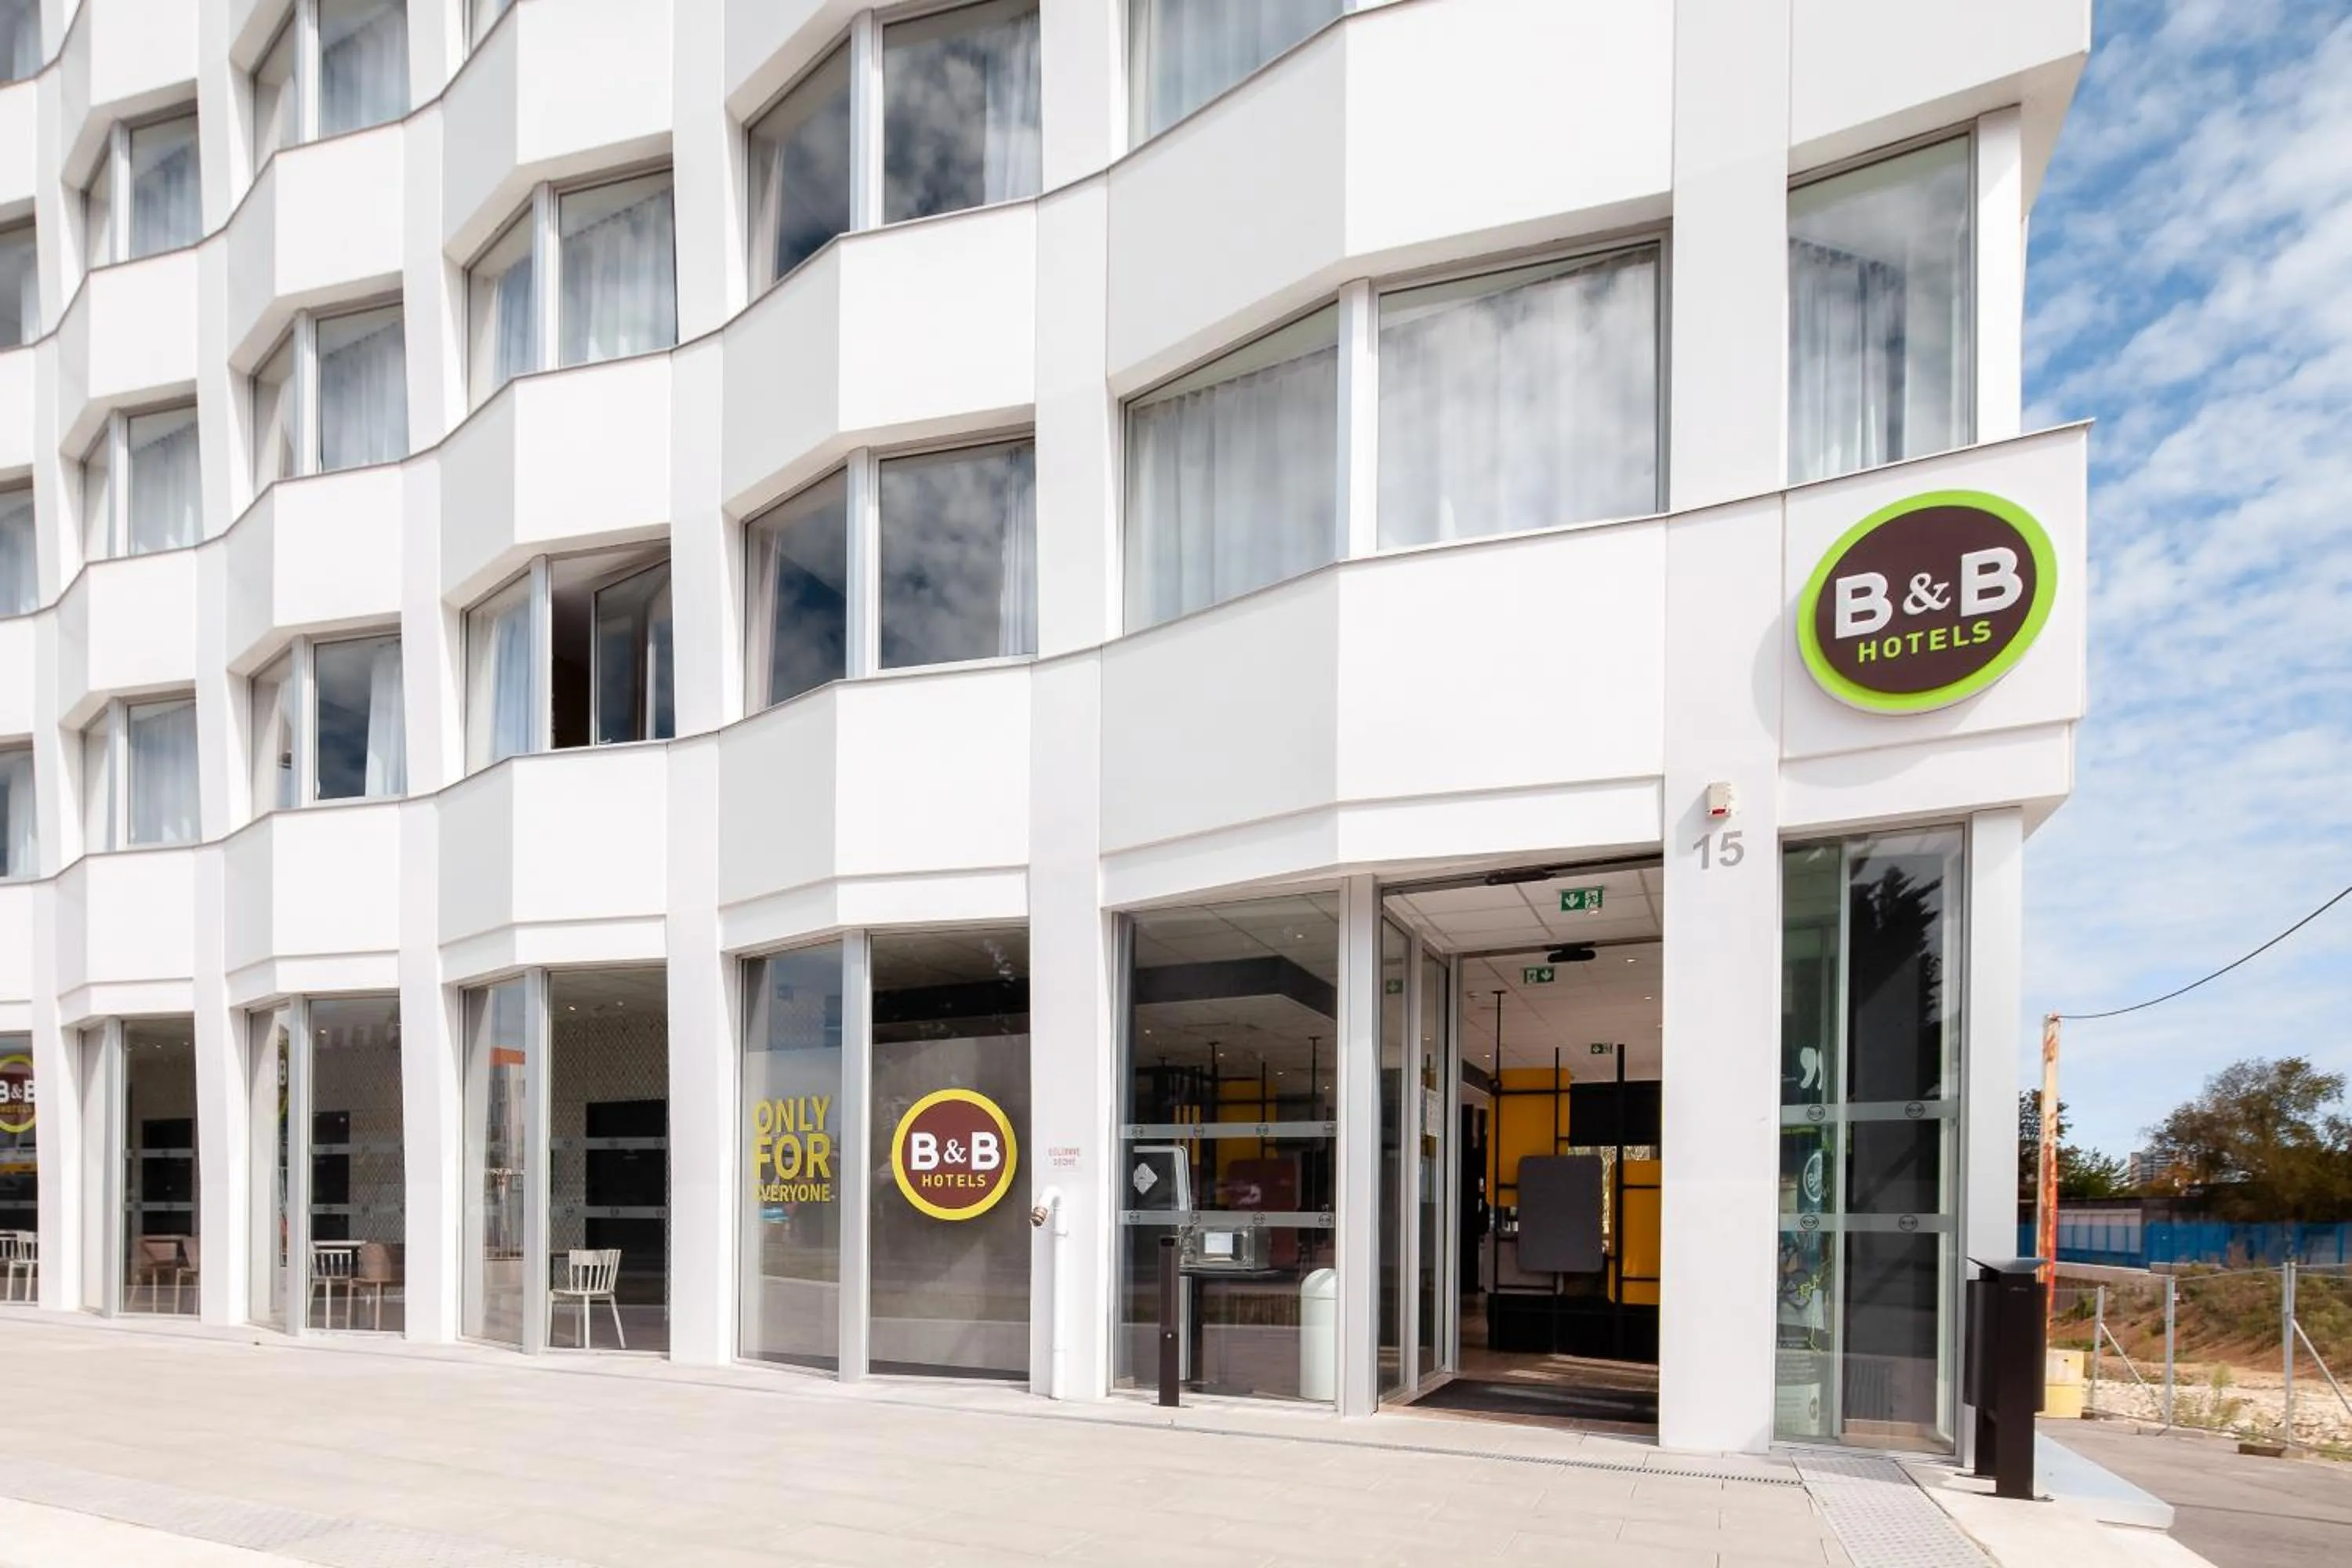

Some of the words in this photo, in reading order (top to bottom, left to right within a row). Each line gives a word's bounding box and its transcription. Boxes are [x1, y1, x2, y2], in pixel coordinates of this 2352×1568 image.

[1835, 546, 2023, 639] B&B
[1858, 620, 1992, 663] HOTELS
[1693, 831, 1744, 870] 15
[753, 1095, 832, 1134] ONLY
[754, 1133, 832, 1180] FOR
[911, 1131, 1000, 1171] B&B
[922, 1174, 986, 1188] HOTELS
